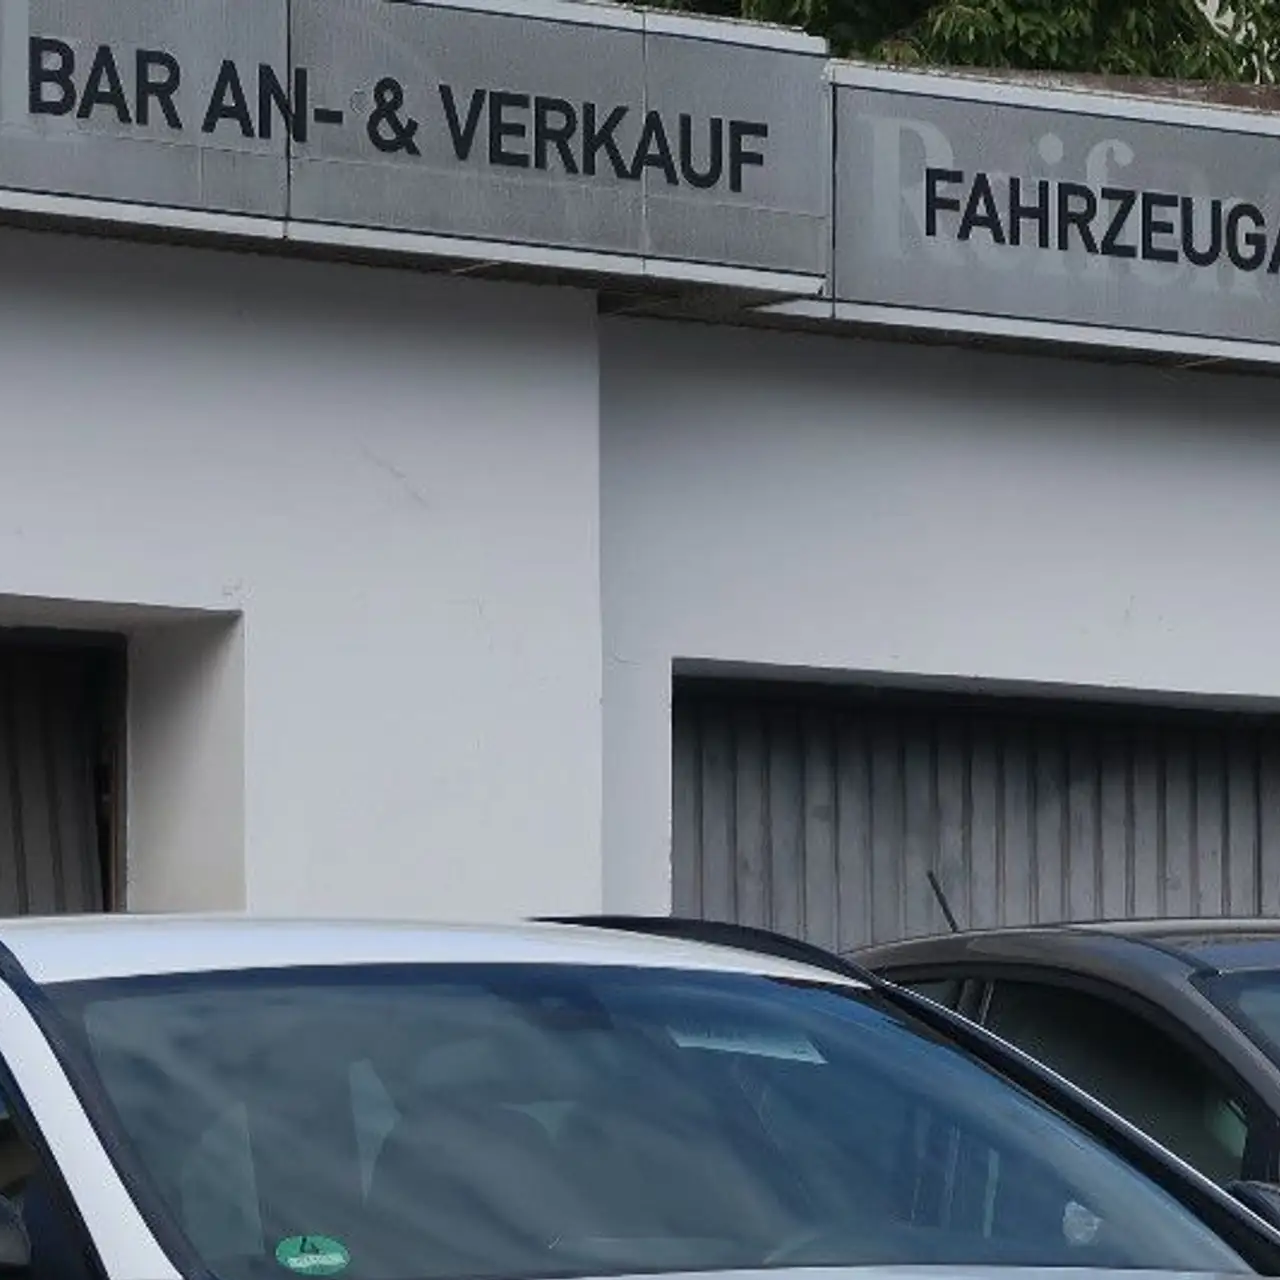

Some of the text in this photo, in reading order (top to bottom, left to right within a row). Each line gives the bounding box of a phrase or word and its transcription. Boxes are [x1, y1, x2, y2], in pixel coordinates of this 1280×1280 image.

[28, 36, 183, 130] BAR
[201, 59, 344, 143] AN-
[368, 76, 421, 157] &
[439, 84, 769, 193] VERKAUF
